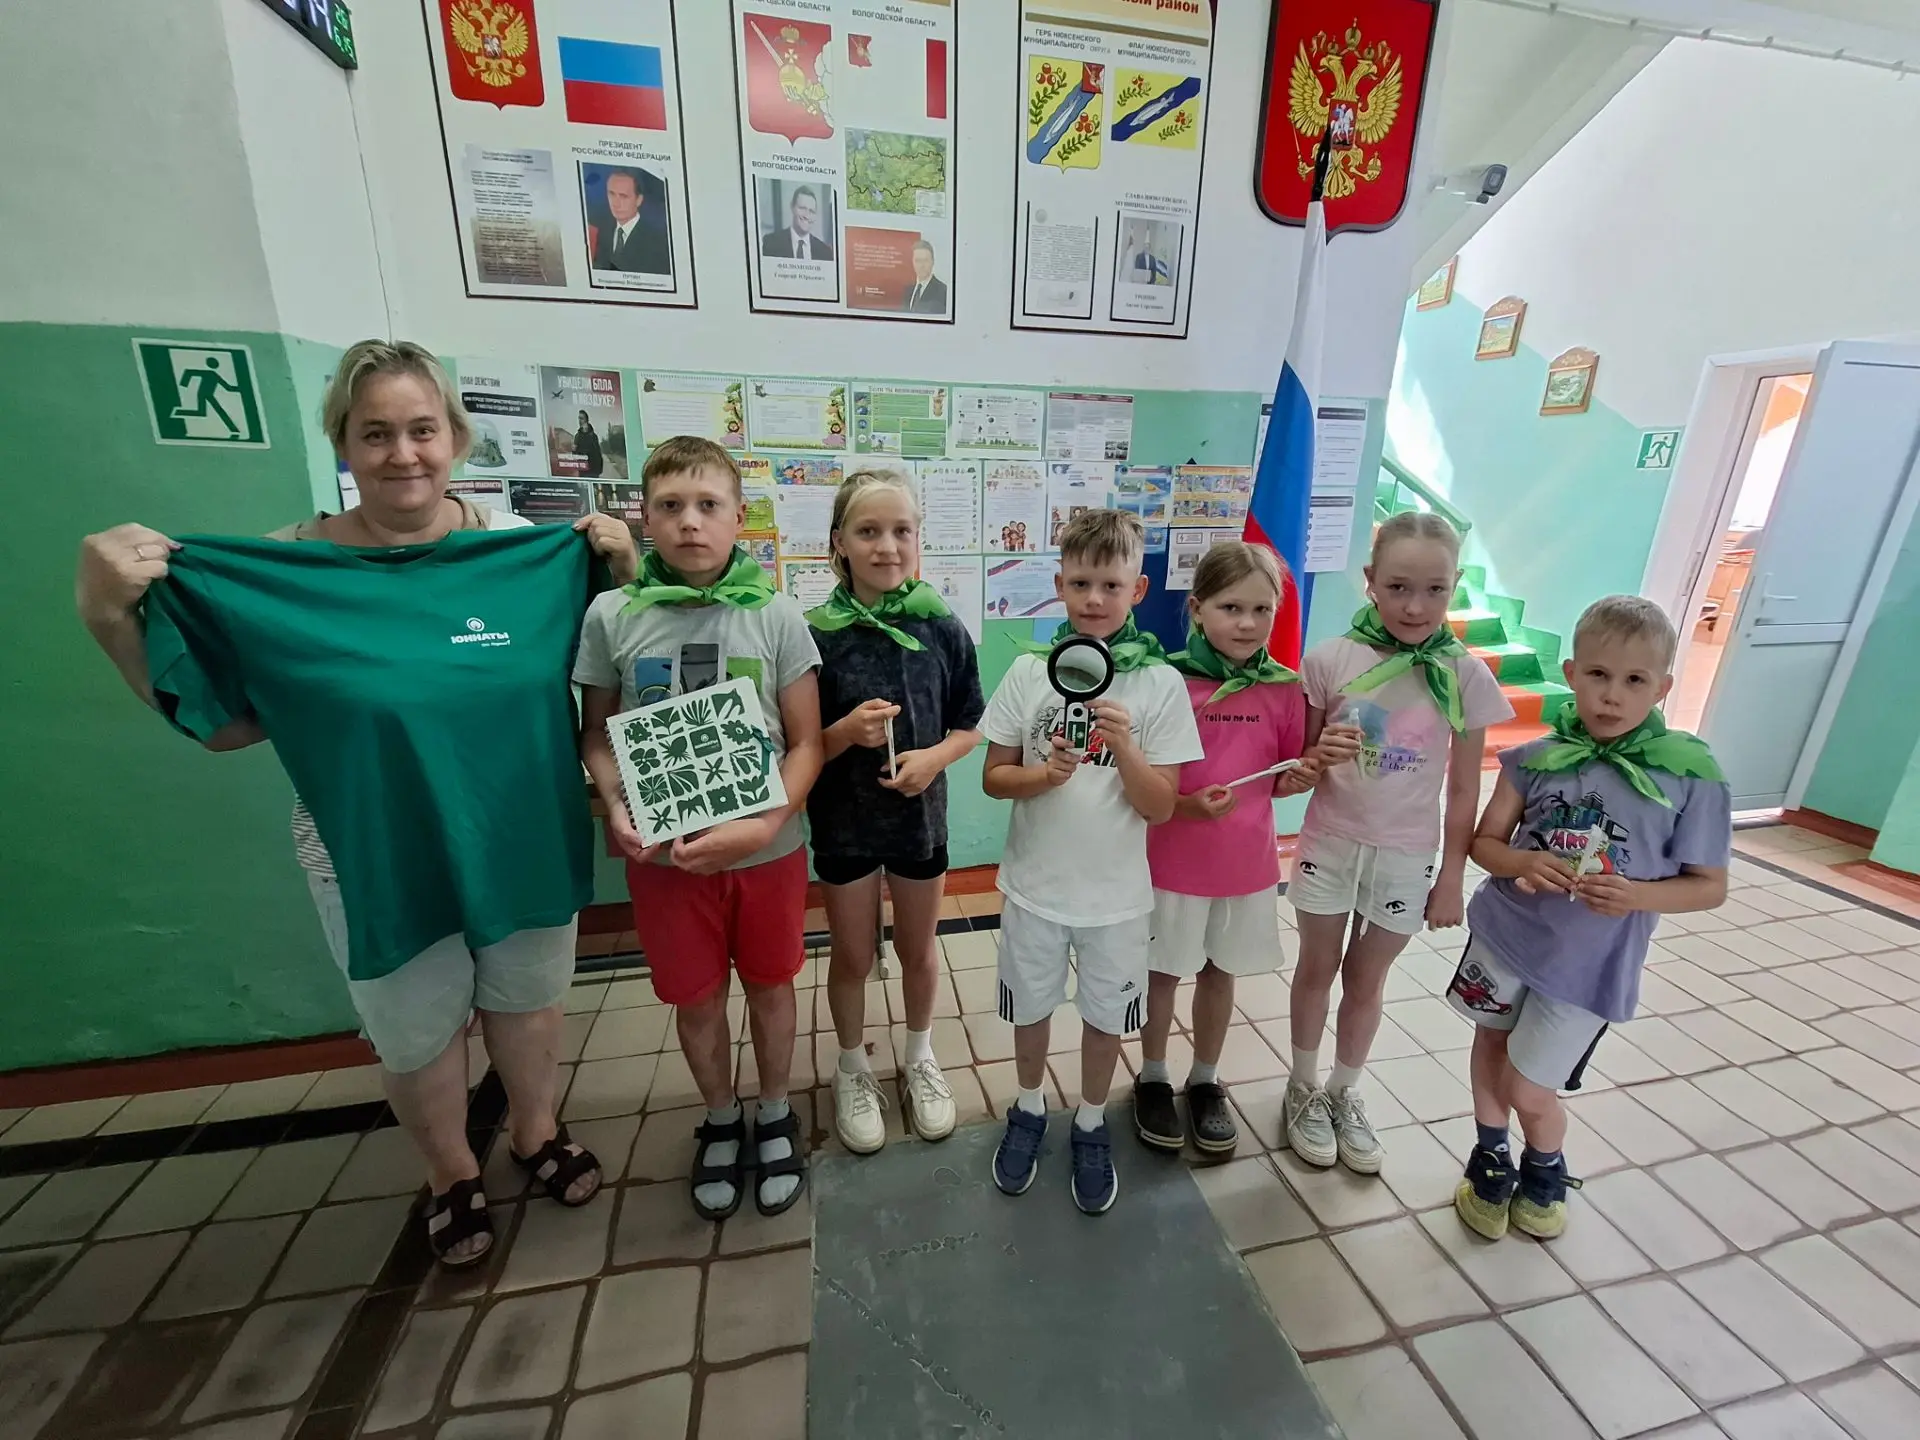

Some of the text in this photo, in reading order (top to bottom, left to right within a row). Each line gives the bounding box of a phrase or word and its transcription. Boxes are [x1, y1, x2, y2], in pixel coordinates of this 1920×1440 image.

[885, 5, 904, 13] ФЛАГ
[852, 9, 937, 27] ВОЛОГОДСКОЙ ОБЛАСТИ
[1035, 28, 1102, 43] ГЕРБ НЮКСЕНСКОГО
[1024, 36, 1085, 50] МУНИЦИПАЛЬНОГО
[1128, 41, 1191, 57] ФЛАГ НЮКСЕНСКОГО
[1117, 49, 1175, 63] МУНИЦИПАЛЬНОГО
[598, 140, 643, 151] ПРЕЗИДЕНТ
[571, 146, 672, 162] РОССИЙСКОЙ ФЕДЕРАЦИИ
[772, 154, 816, 165] ГУБЕРНАТОР
[751, 160, 837, 175] ВОЛОГОДСКОЙ ОБЛАСТИ
[557, 375, 613, 392] УВИДЕЛИ БПЛА
[1205, 712, 1232, 723] follow
[1245, 714, 1260, 723] out
[1365, 759, 1383, 768] get
